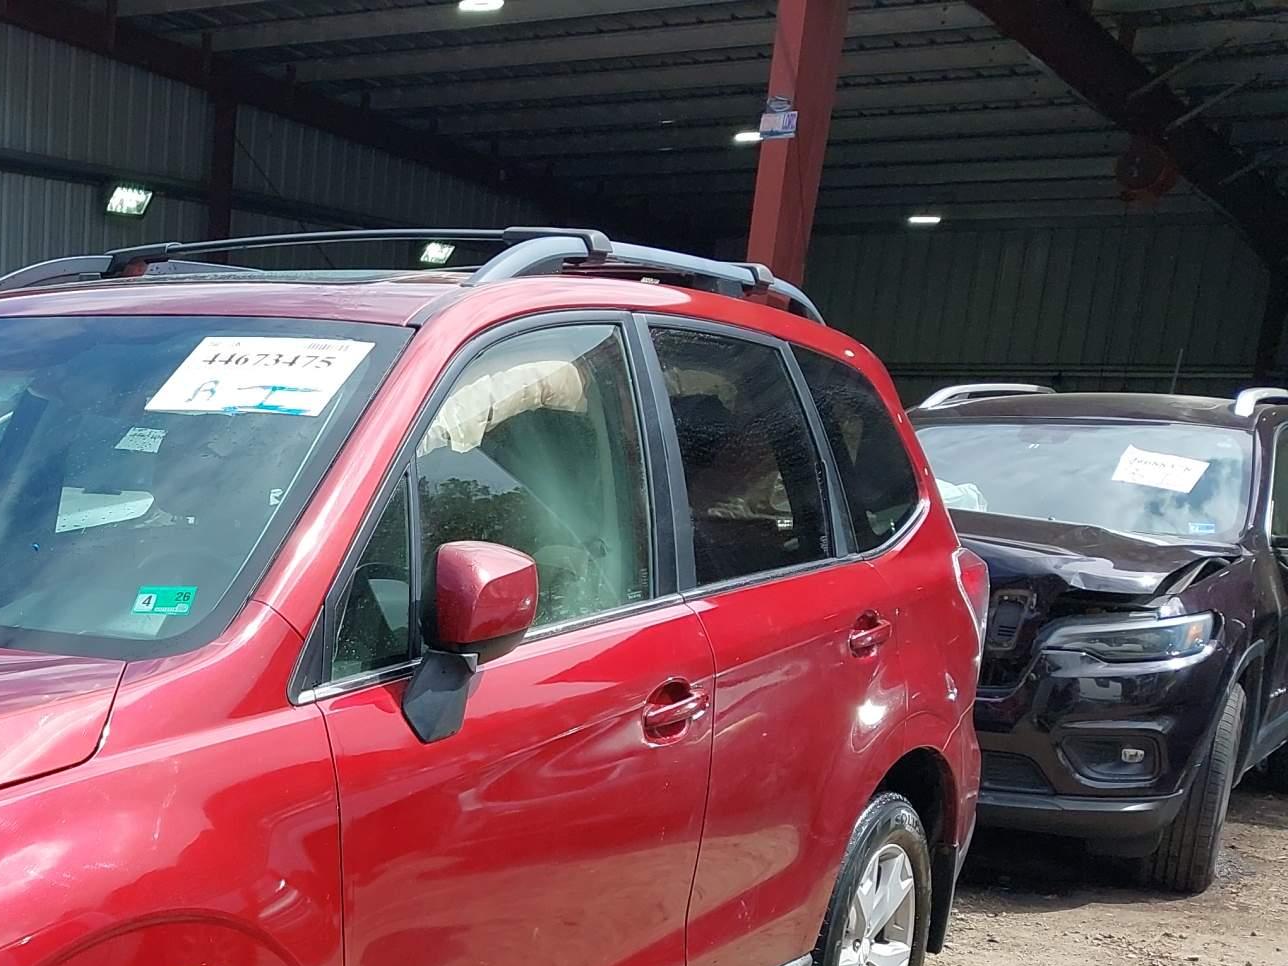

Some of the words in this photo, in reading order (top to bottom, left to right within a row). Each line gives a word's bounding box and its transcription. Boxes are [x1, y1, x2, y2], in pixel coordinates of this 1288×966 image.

[202, 352, 337, 369] 44673475
[141, 594, 153, 607] 4
[175, 591, 192, 602] 26
